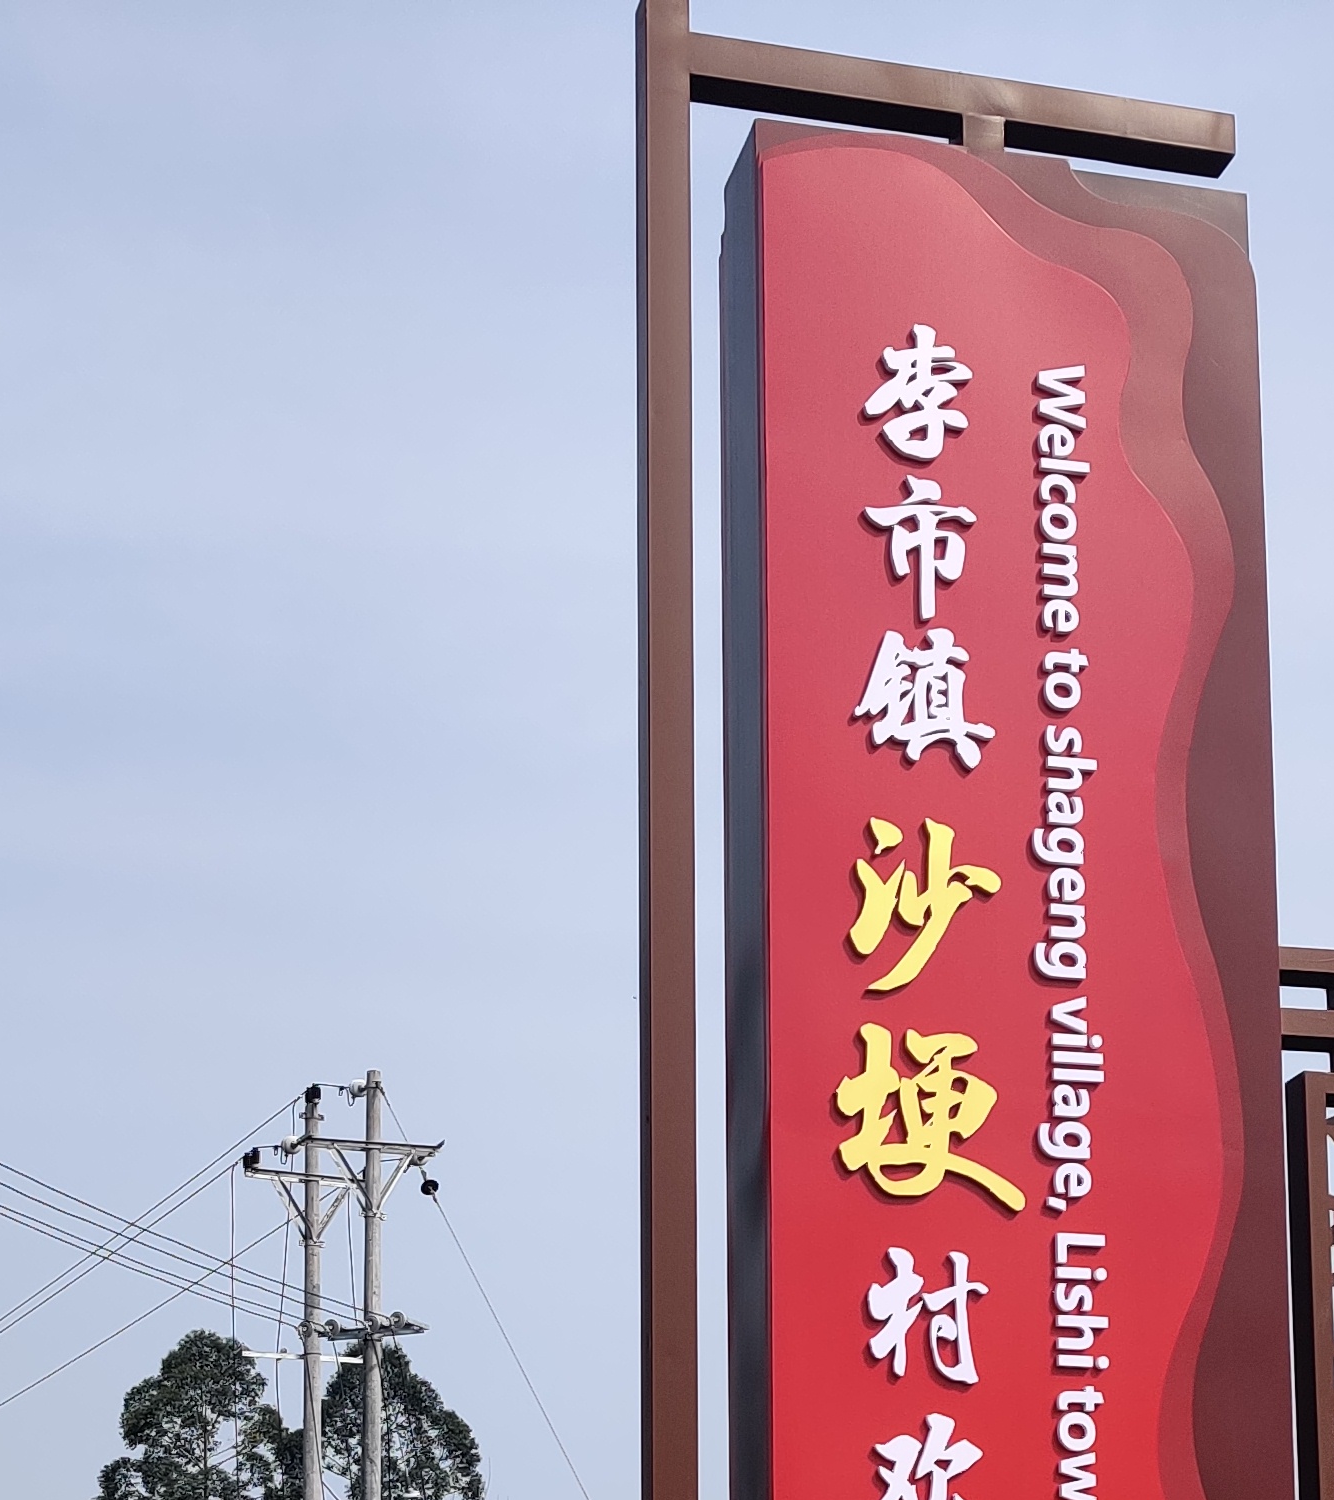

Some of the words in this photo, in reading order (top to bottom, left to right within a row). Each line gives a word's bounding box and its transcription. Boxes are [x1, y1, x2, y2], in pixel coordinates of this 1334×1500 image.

[1036, 364, 1091, 633] Welcome
[1042, 648, 1089, 711] to
[1032, 725, 1098, 981] shageng
[1036, 996, 1106, 1211] village,
[1053, 1232, 1109, 1370] Lishi
